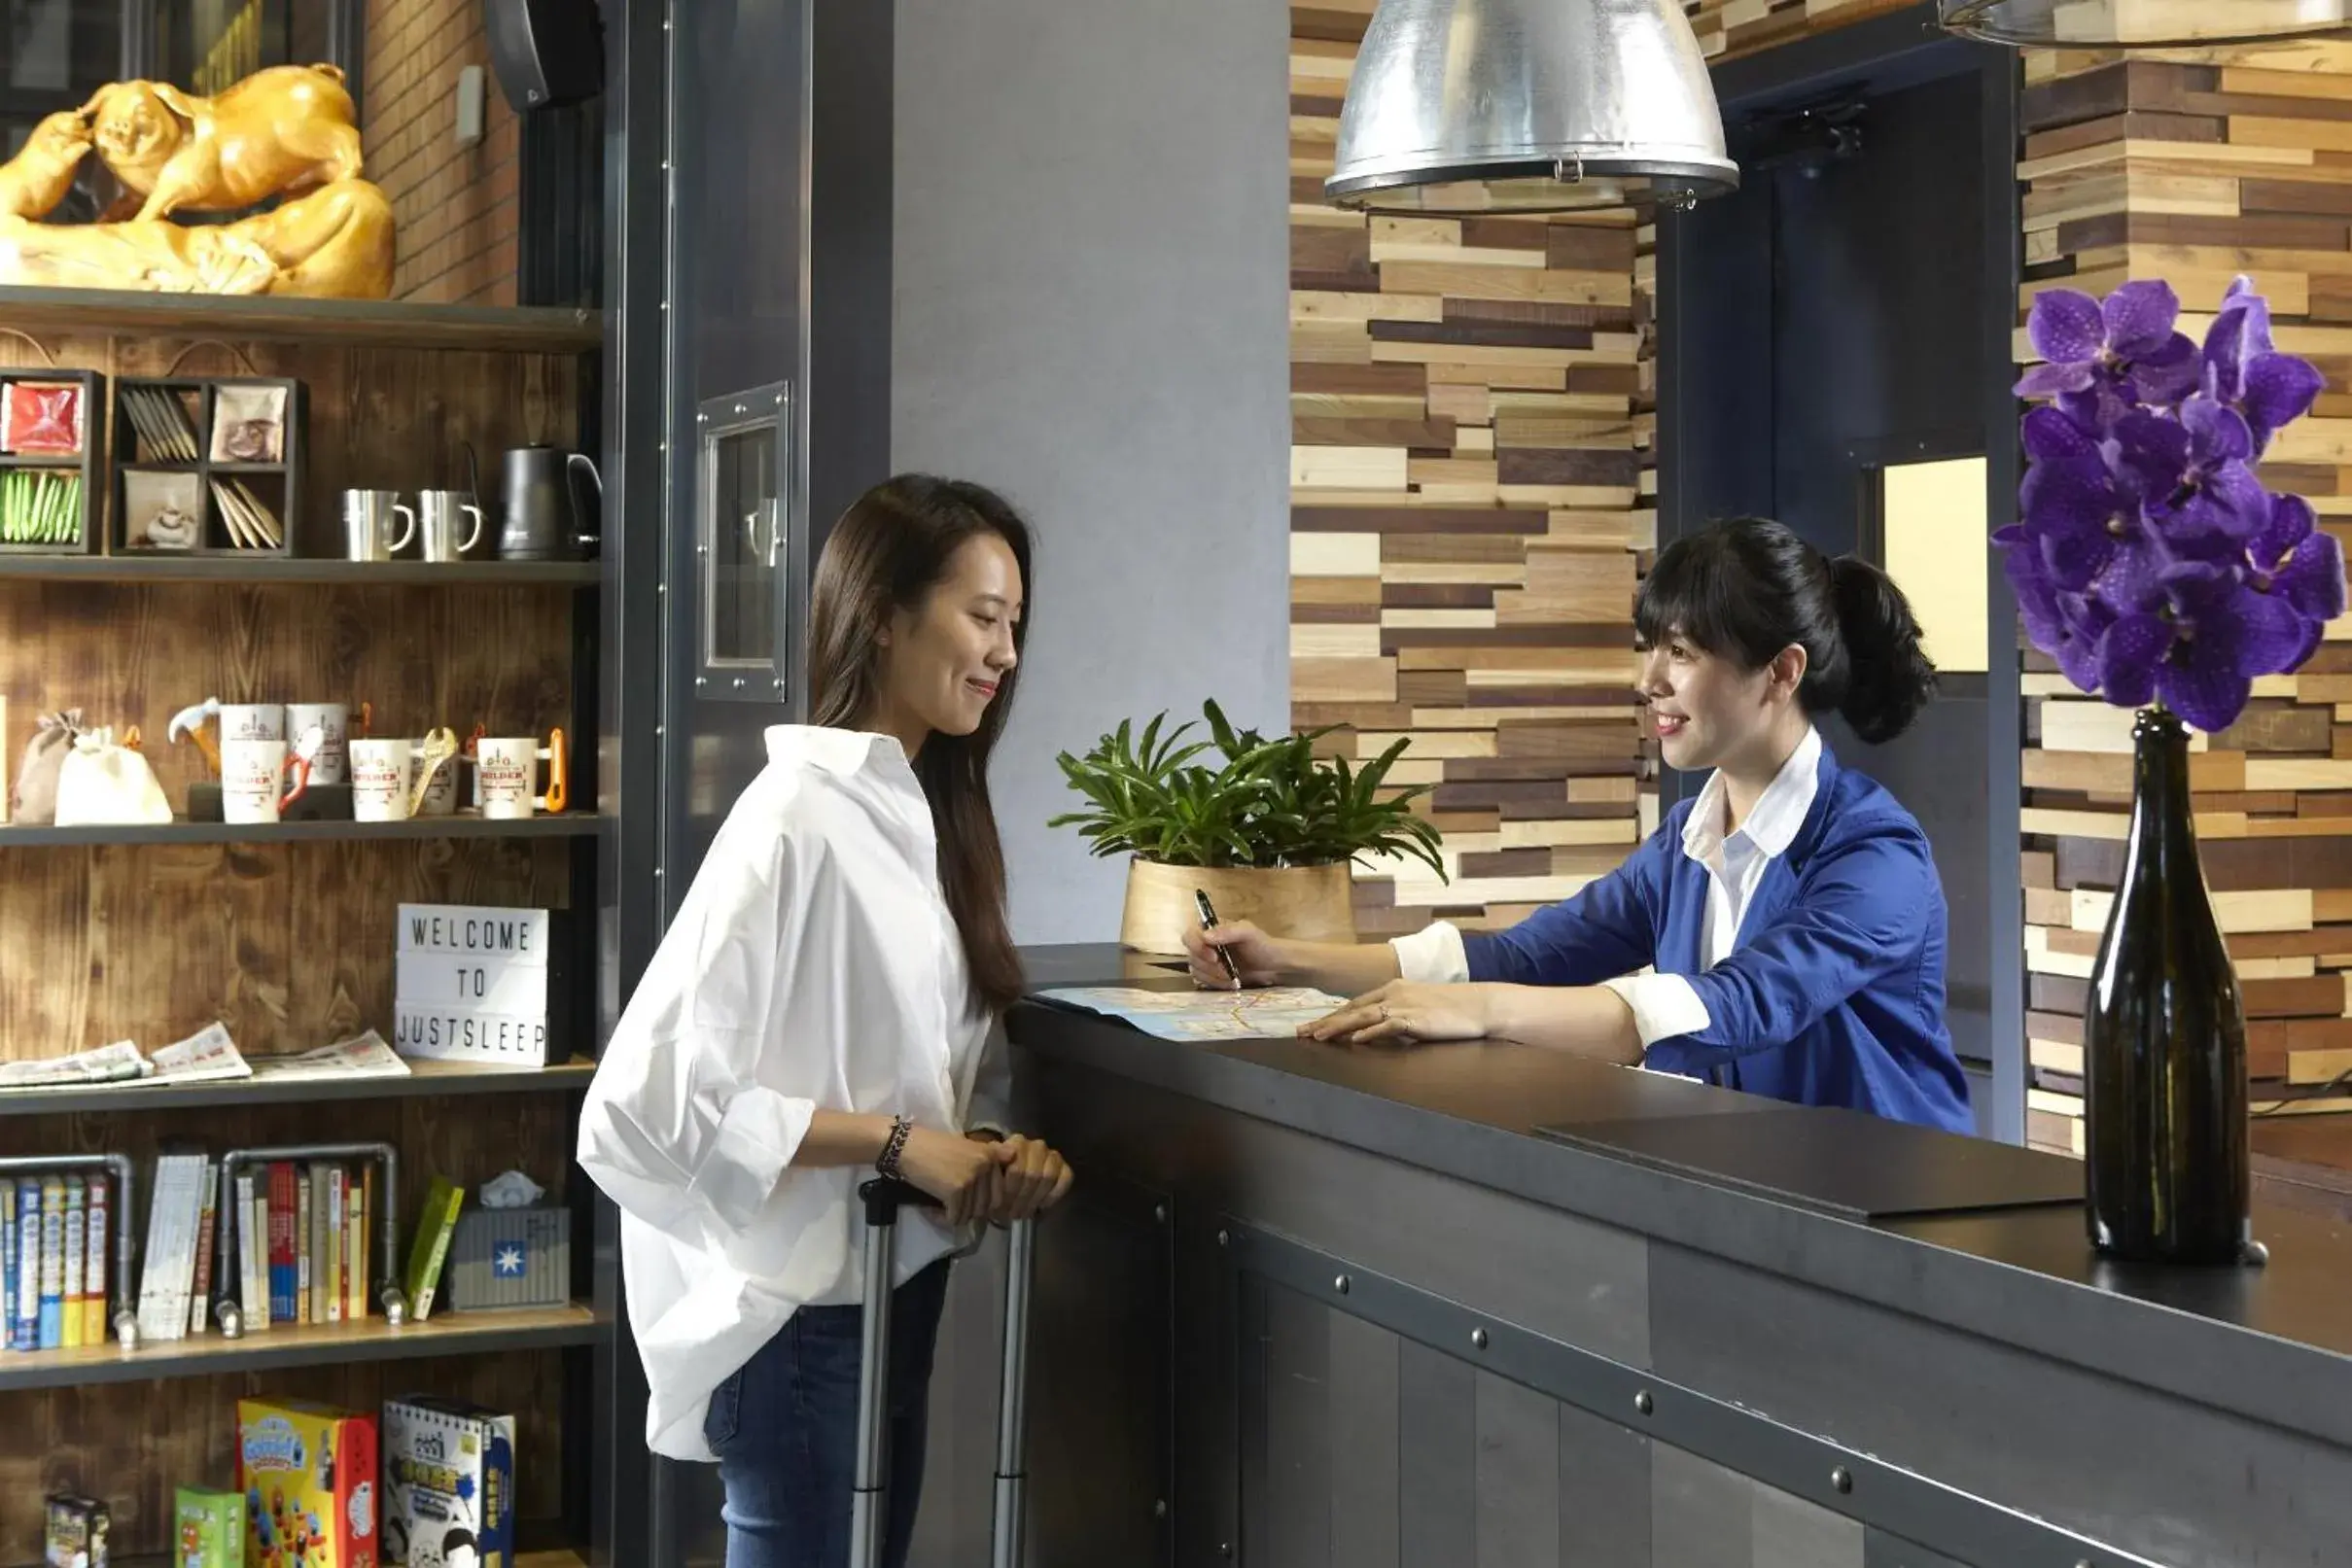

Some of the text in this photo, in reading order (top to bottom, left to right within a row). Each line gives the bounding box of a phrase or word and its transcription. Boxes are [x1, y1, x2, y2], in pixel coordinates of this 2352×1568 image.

[412, 917, 529, 951] WELCOME
[457, 968, 485, 998] TO
[398, 1014, 546, 1052] JUSTSLEEP
